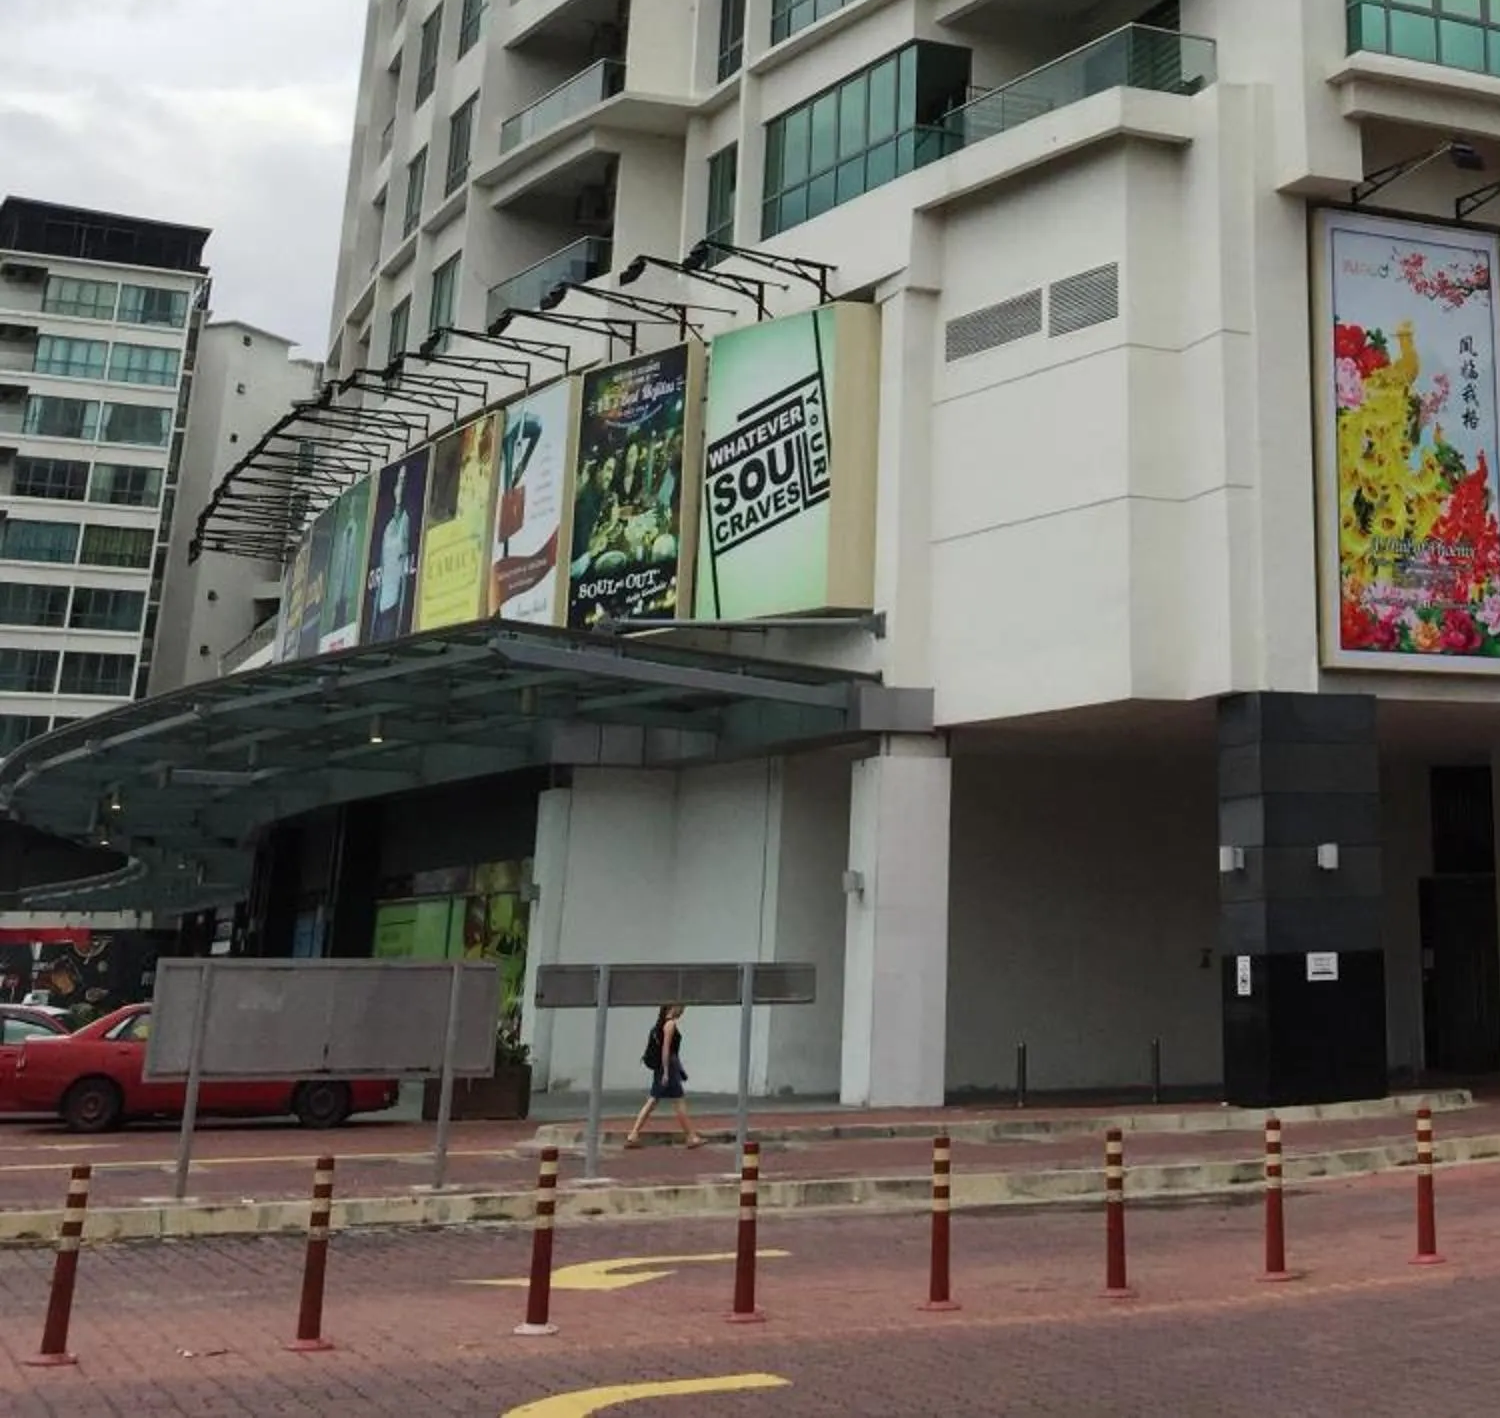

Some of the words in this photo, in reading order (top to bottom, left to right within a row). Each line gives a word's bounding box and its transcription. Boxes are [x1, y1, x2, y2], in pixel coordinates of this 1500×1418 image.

[709, 404, 804, 470] WHATEVER
[806, 386, 828, 480] YOUR
[715, 481, 800, 544] CRAVES
